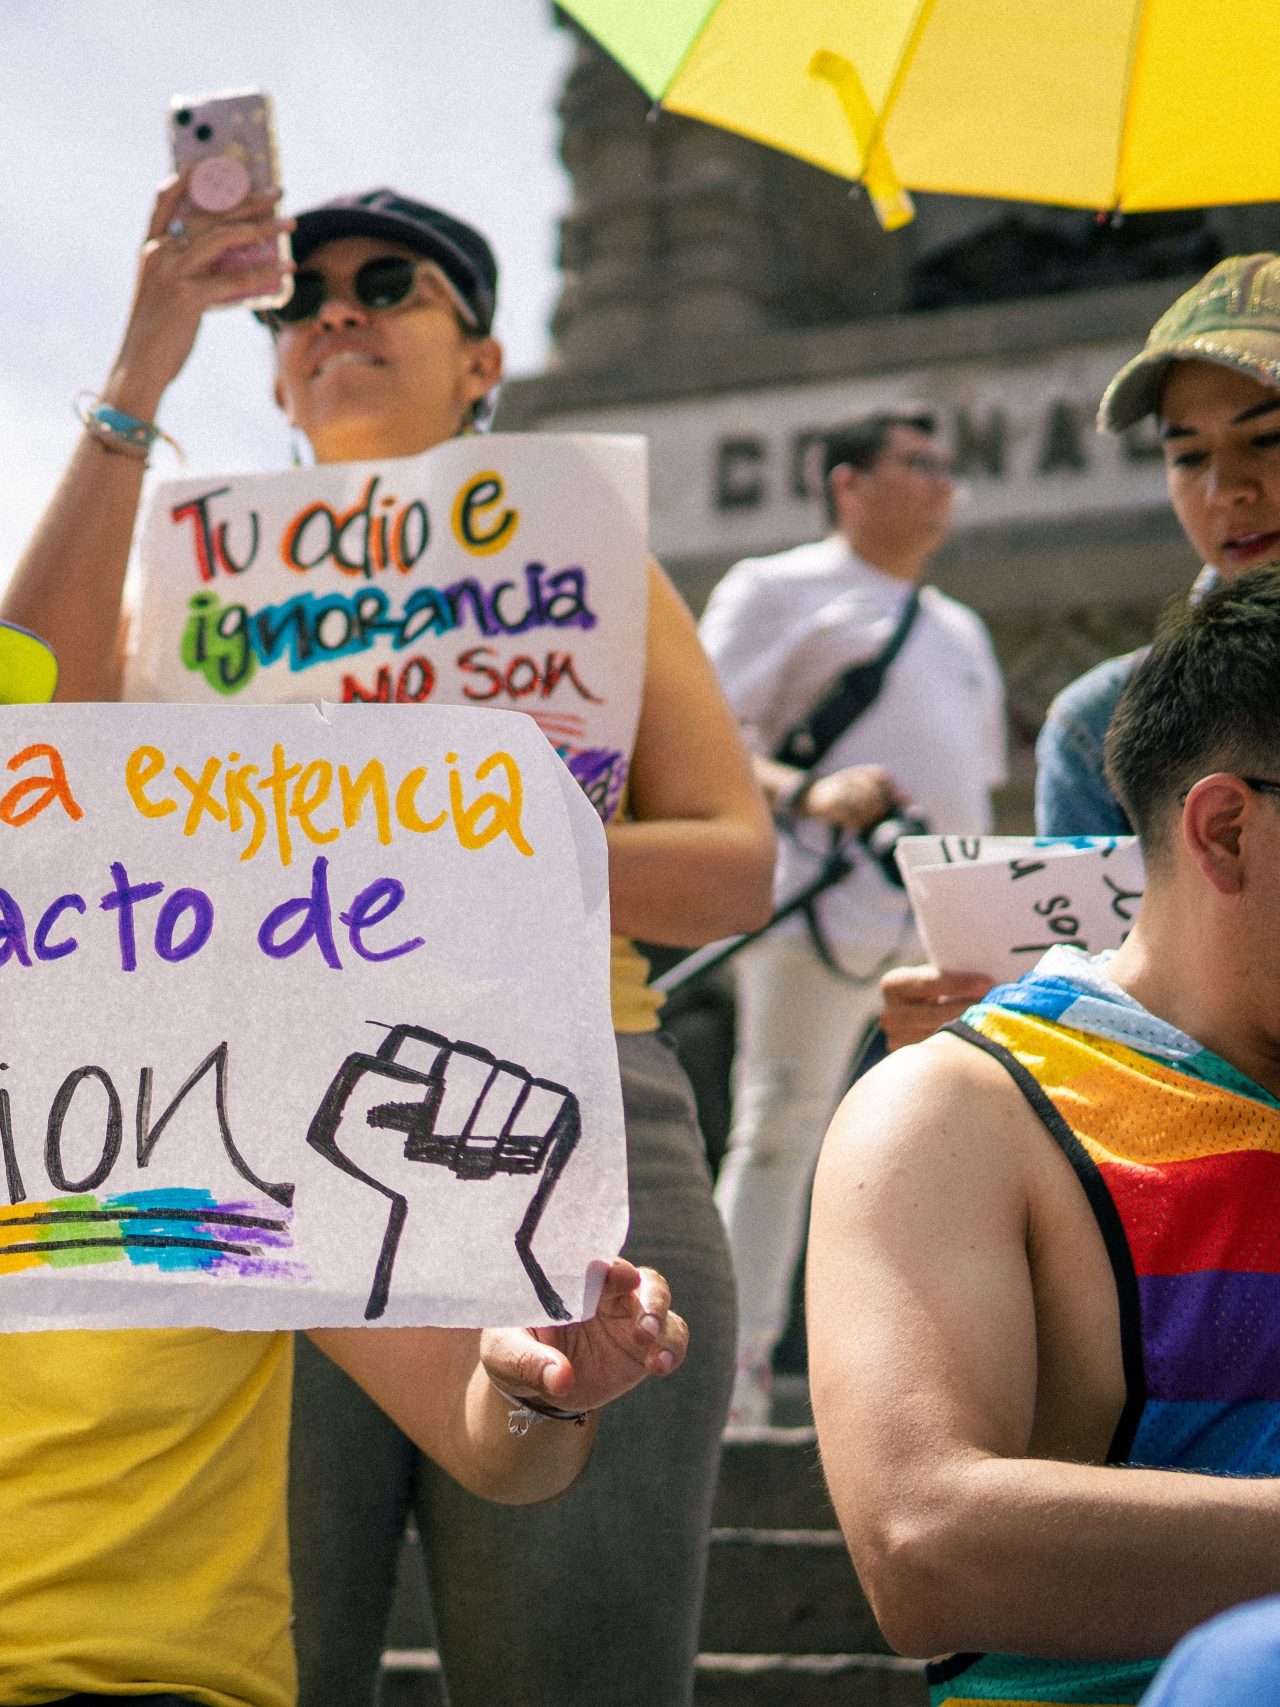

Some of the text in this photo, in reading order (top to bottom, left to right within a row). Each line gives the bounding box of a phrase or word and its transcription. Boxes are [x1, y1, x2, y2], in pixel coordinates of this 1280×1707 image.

[279, 476, 433, 580] odio
[451, 470, 517, 556] e
[124, 743, 534, 866] existencia
[256, 856, 425, 970] de
